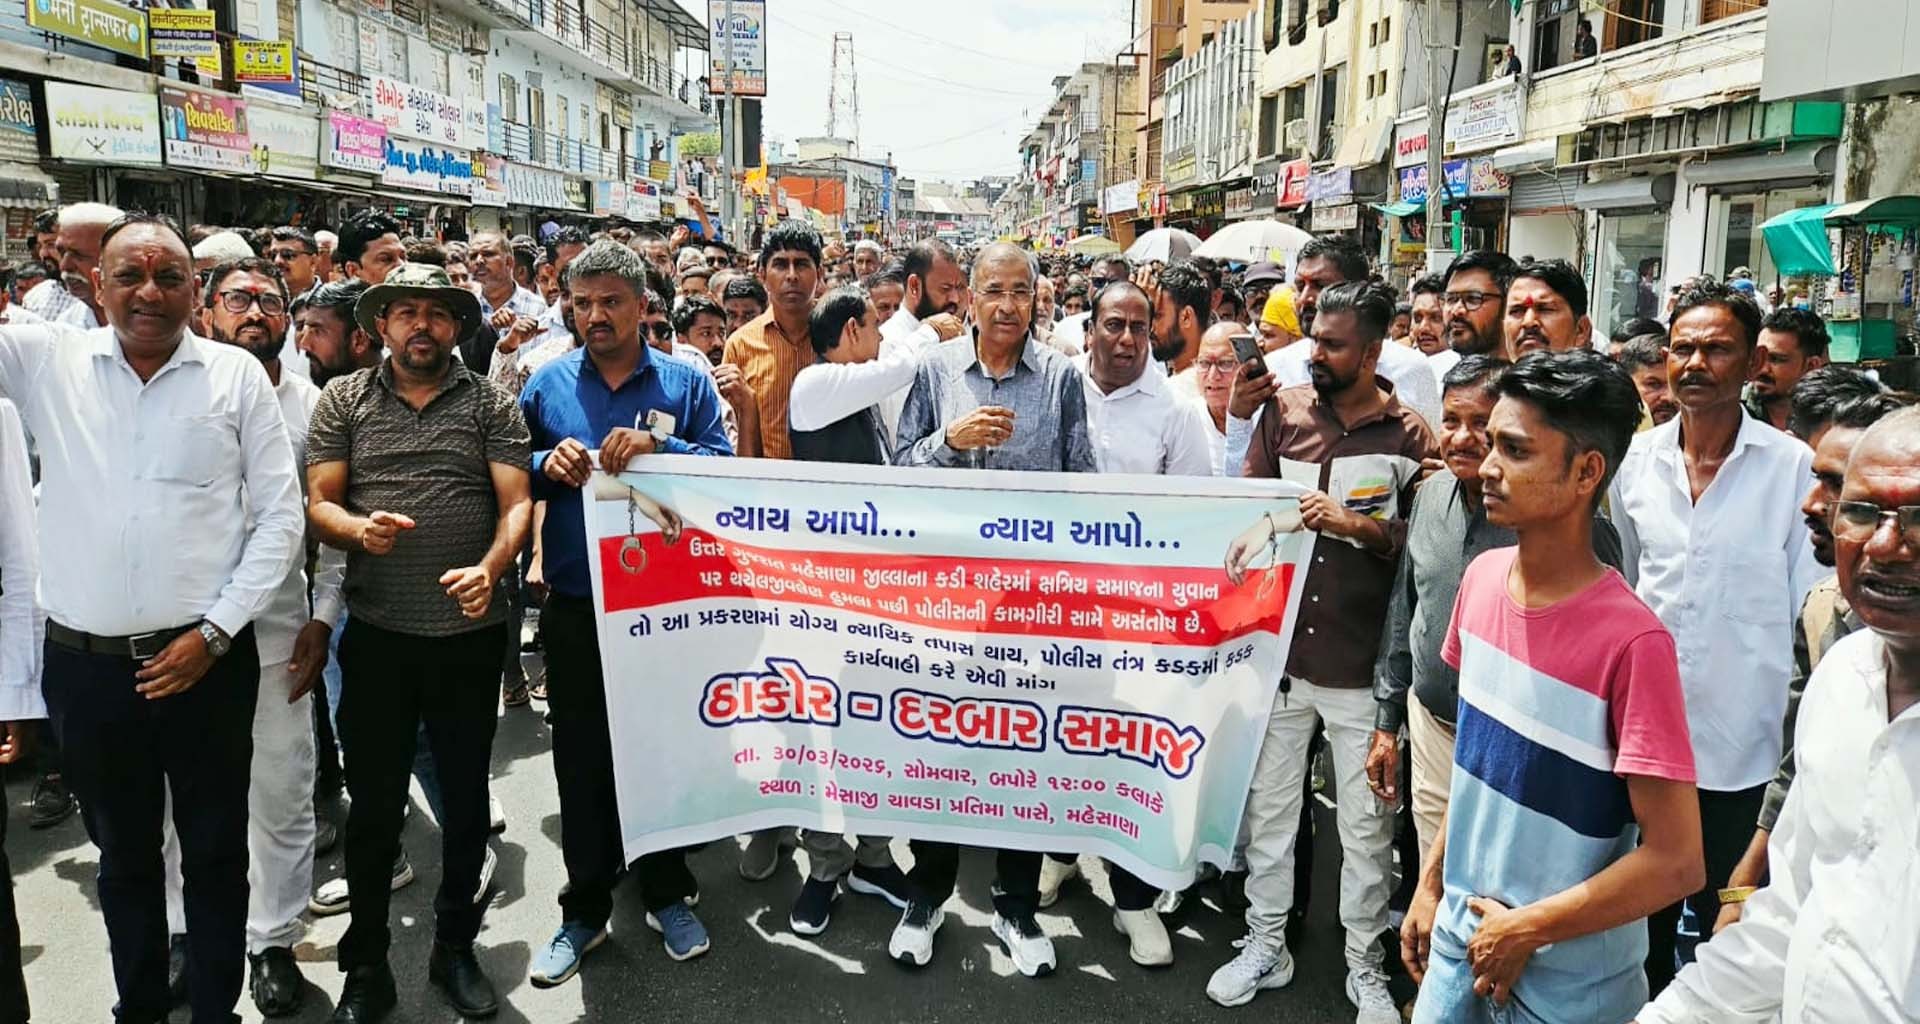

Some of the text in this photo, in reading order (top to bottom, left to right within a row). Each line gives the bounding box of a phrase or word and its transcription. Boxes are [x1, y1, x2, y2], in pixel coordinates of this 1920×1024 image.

[716, 501, 1180, 549] ન્યાય આપો... ન્યાય આપો...
[689, 538, 1219, 607] ઉત્તર ગુજરાત મહેસાણા જીલ્લાના કડી શહેરમાં ક્ષત્રિય સમાજના યુવાન
[699, 571, 722, 588] પર
[829, 590, 872, 609] હુમલા
[877, 596, 908, 616] પછી
[915, 596, 986, 622] પોલીસની
[994, 602, 1062, 627] કામગીરી
[1070, 604, 1103, 628] સામે
[1111, 606, 1177, 632] અસંતોષ
[1184, 609, 1206, 634] છે.
[629, 607, 1255, 676] તો આ પ્રકરણમાં યોગ્ય ન્યાયિક તપાસ થાય, પોલીસ તંત્ર કડકમાં કડક
[843, 648, 1056, 691] કાર્યવાહી કરે એવી માંગ
[700, 657, 841, 727] ઠાકોર
[891, 688, 1047, 751] દરબાર
[1054, 705, 1205, 779] સમાજ
[733, 747, 760, 766] તા.
[904, 758, 976, 786] સોમવાર,
[989, 768, 1037, 789] બપોરે
[1048, 777, 1106, 792] ૧૨:૦૦
[1116, 782, 1164, 814] કલાકે
[759, 779, 801, 796] સ્થળ
[824, 781, 878, 809] મેસાજી
[888, 793, 941, 811] ચાવડા
[950, 796, 1004, 818] પ્રતિમા
[1013, 803, 1055, 824] પાસે,
[1066, 805, 1139, 839] મહેસાણા
